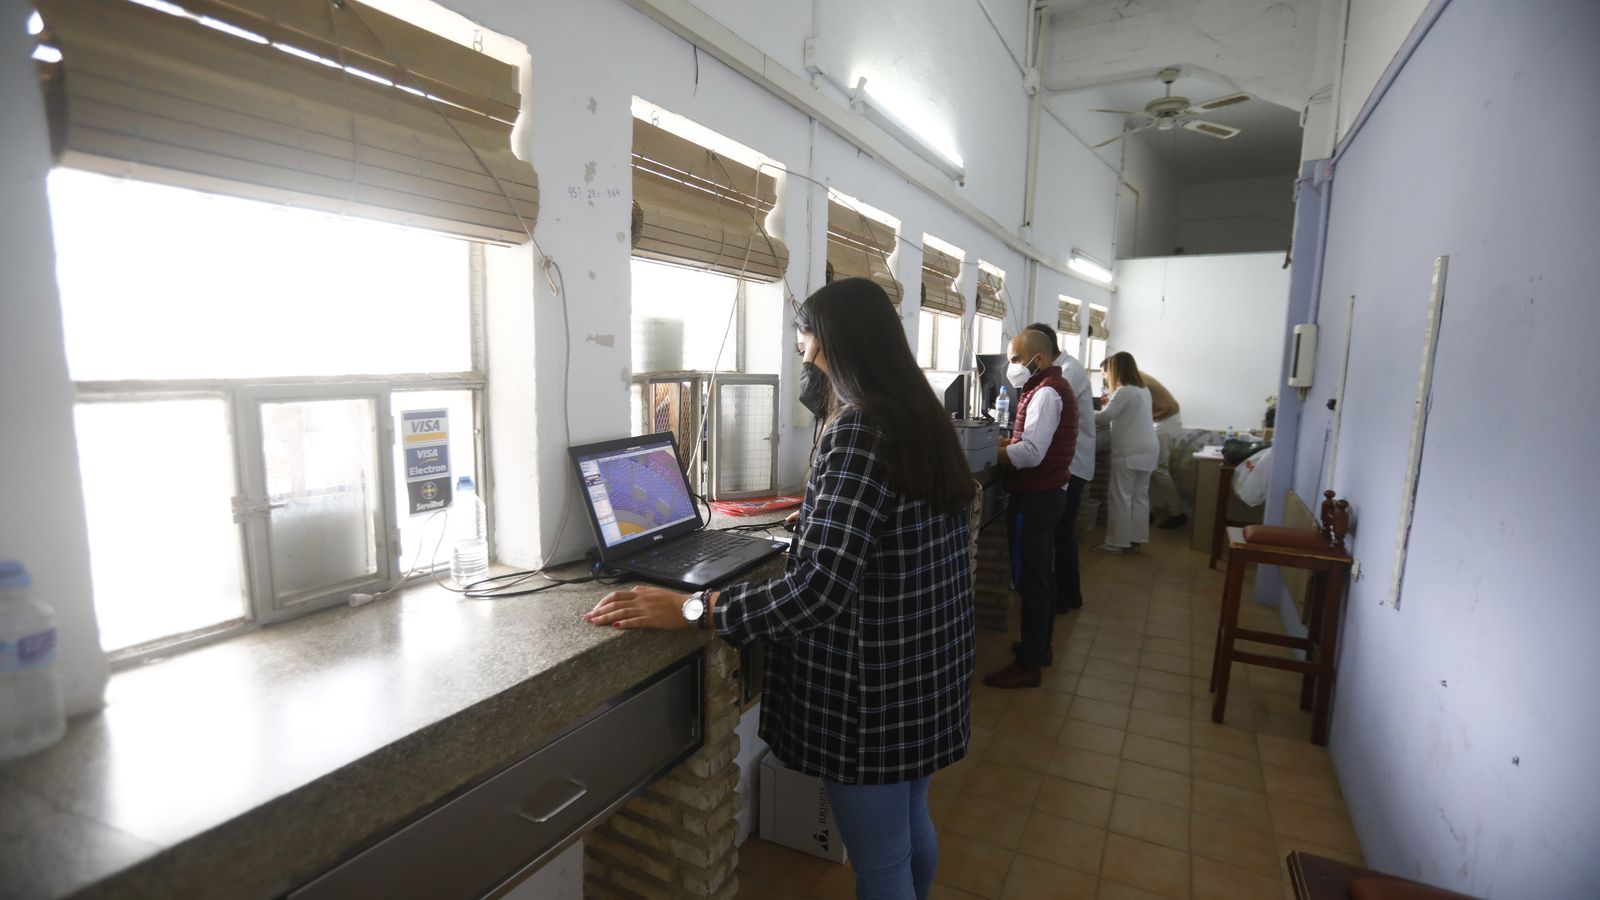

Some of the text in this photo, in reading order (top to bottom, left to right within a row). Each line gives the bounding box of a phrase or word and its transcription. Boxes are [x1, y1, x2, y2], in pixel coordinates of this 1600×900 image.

[410, 420, 440, 433] VISA
[416, 449, 438, 459] VISA
[409, 464, 447, 475] Electron
